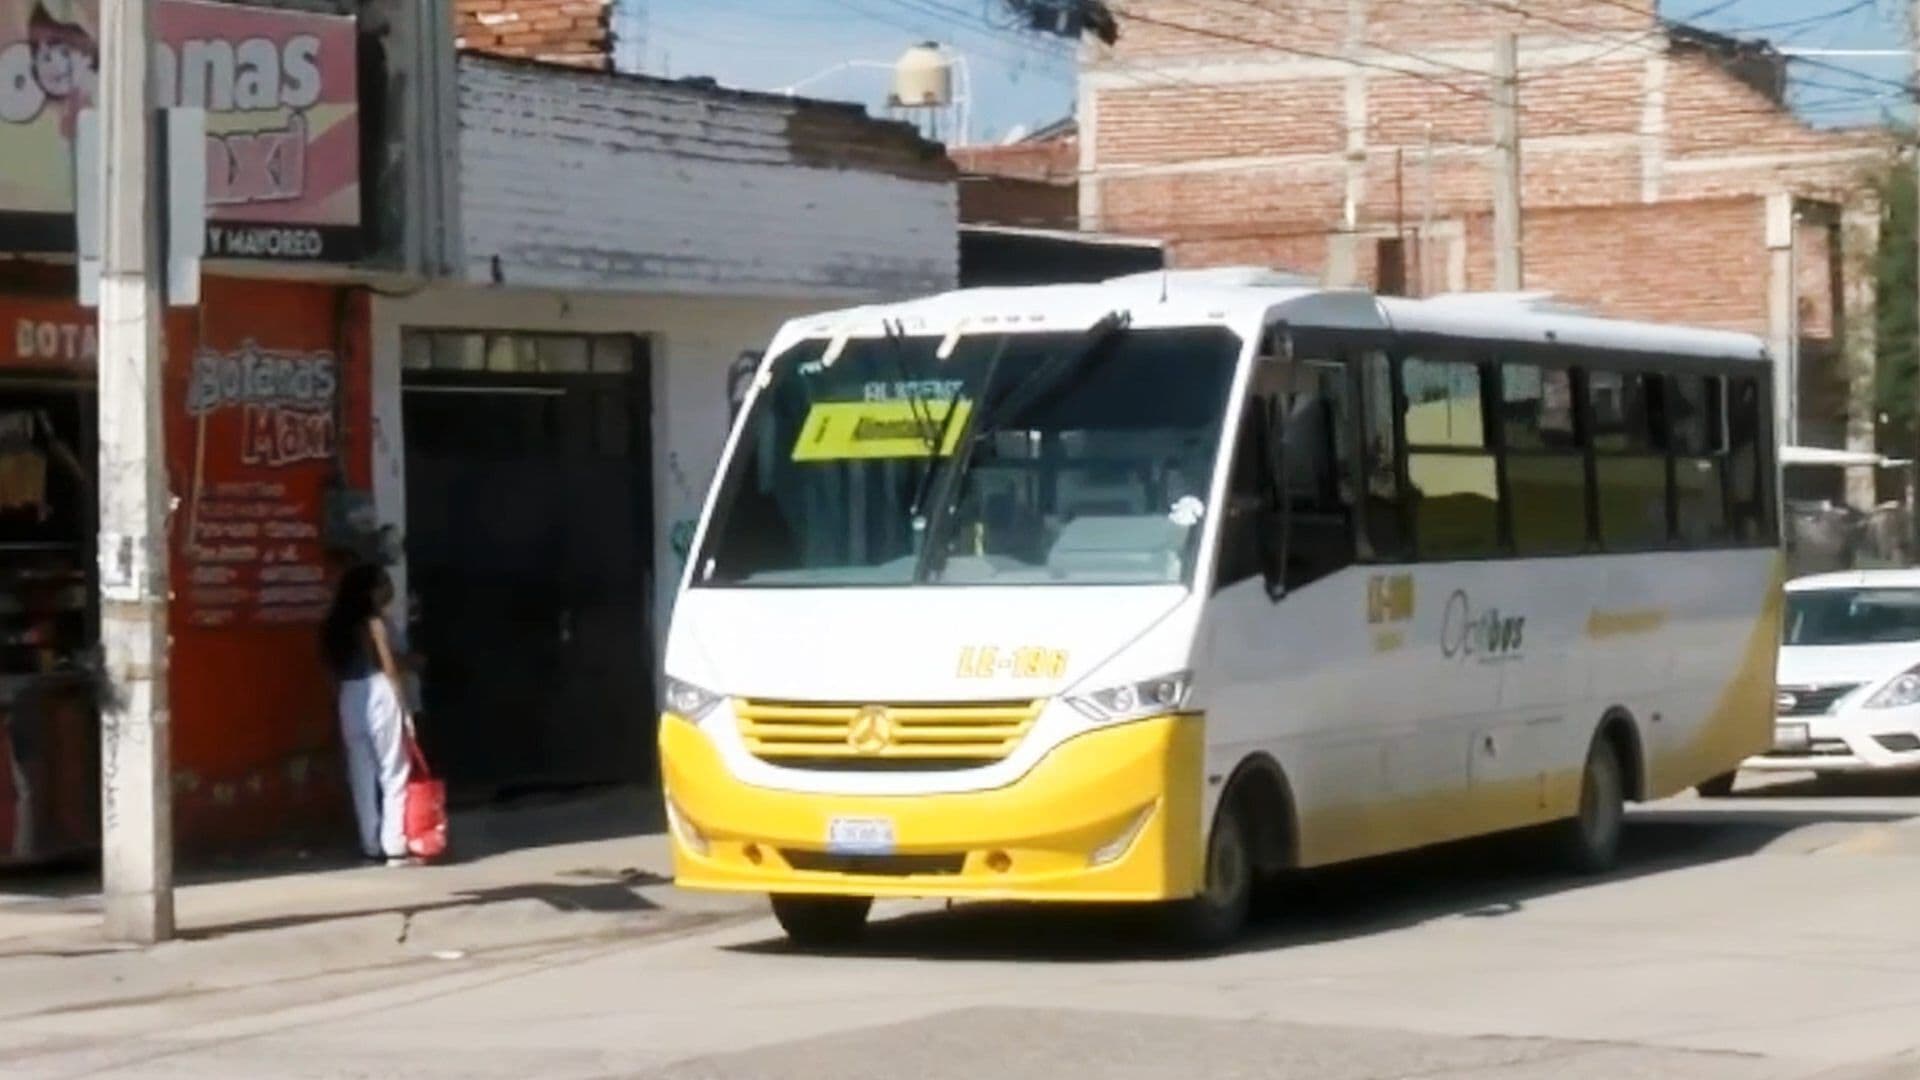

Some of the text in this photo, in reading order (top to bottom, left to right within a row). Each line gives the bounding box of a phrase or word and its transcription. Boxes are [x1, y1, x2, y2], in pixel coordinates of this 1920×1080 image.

[226, 229, 323, 258] MAYOREO
[15, 317, 98, 361] BOTA
[187, 344, 336, 414] Botanas
